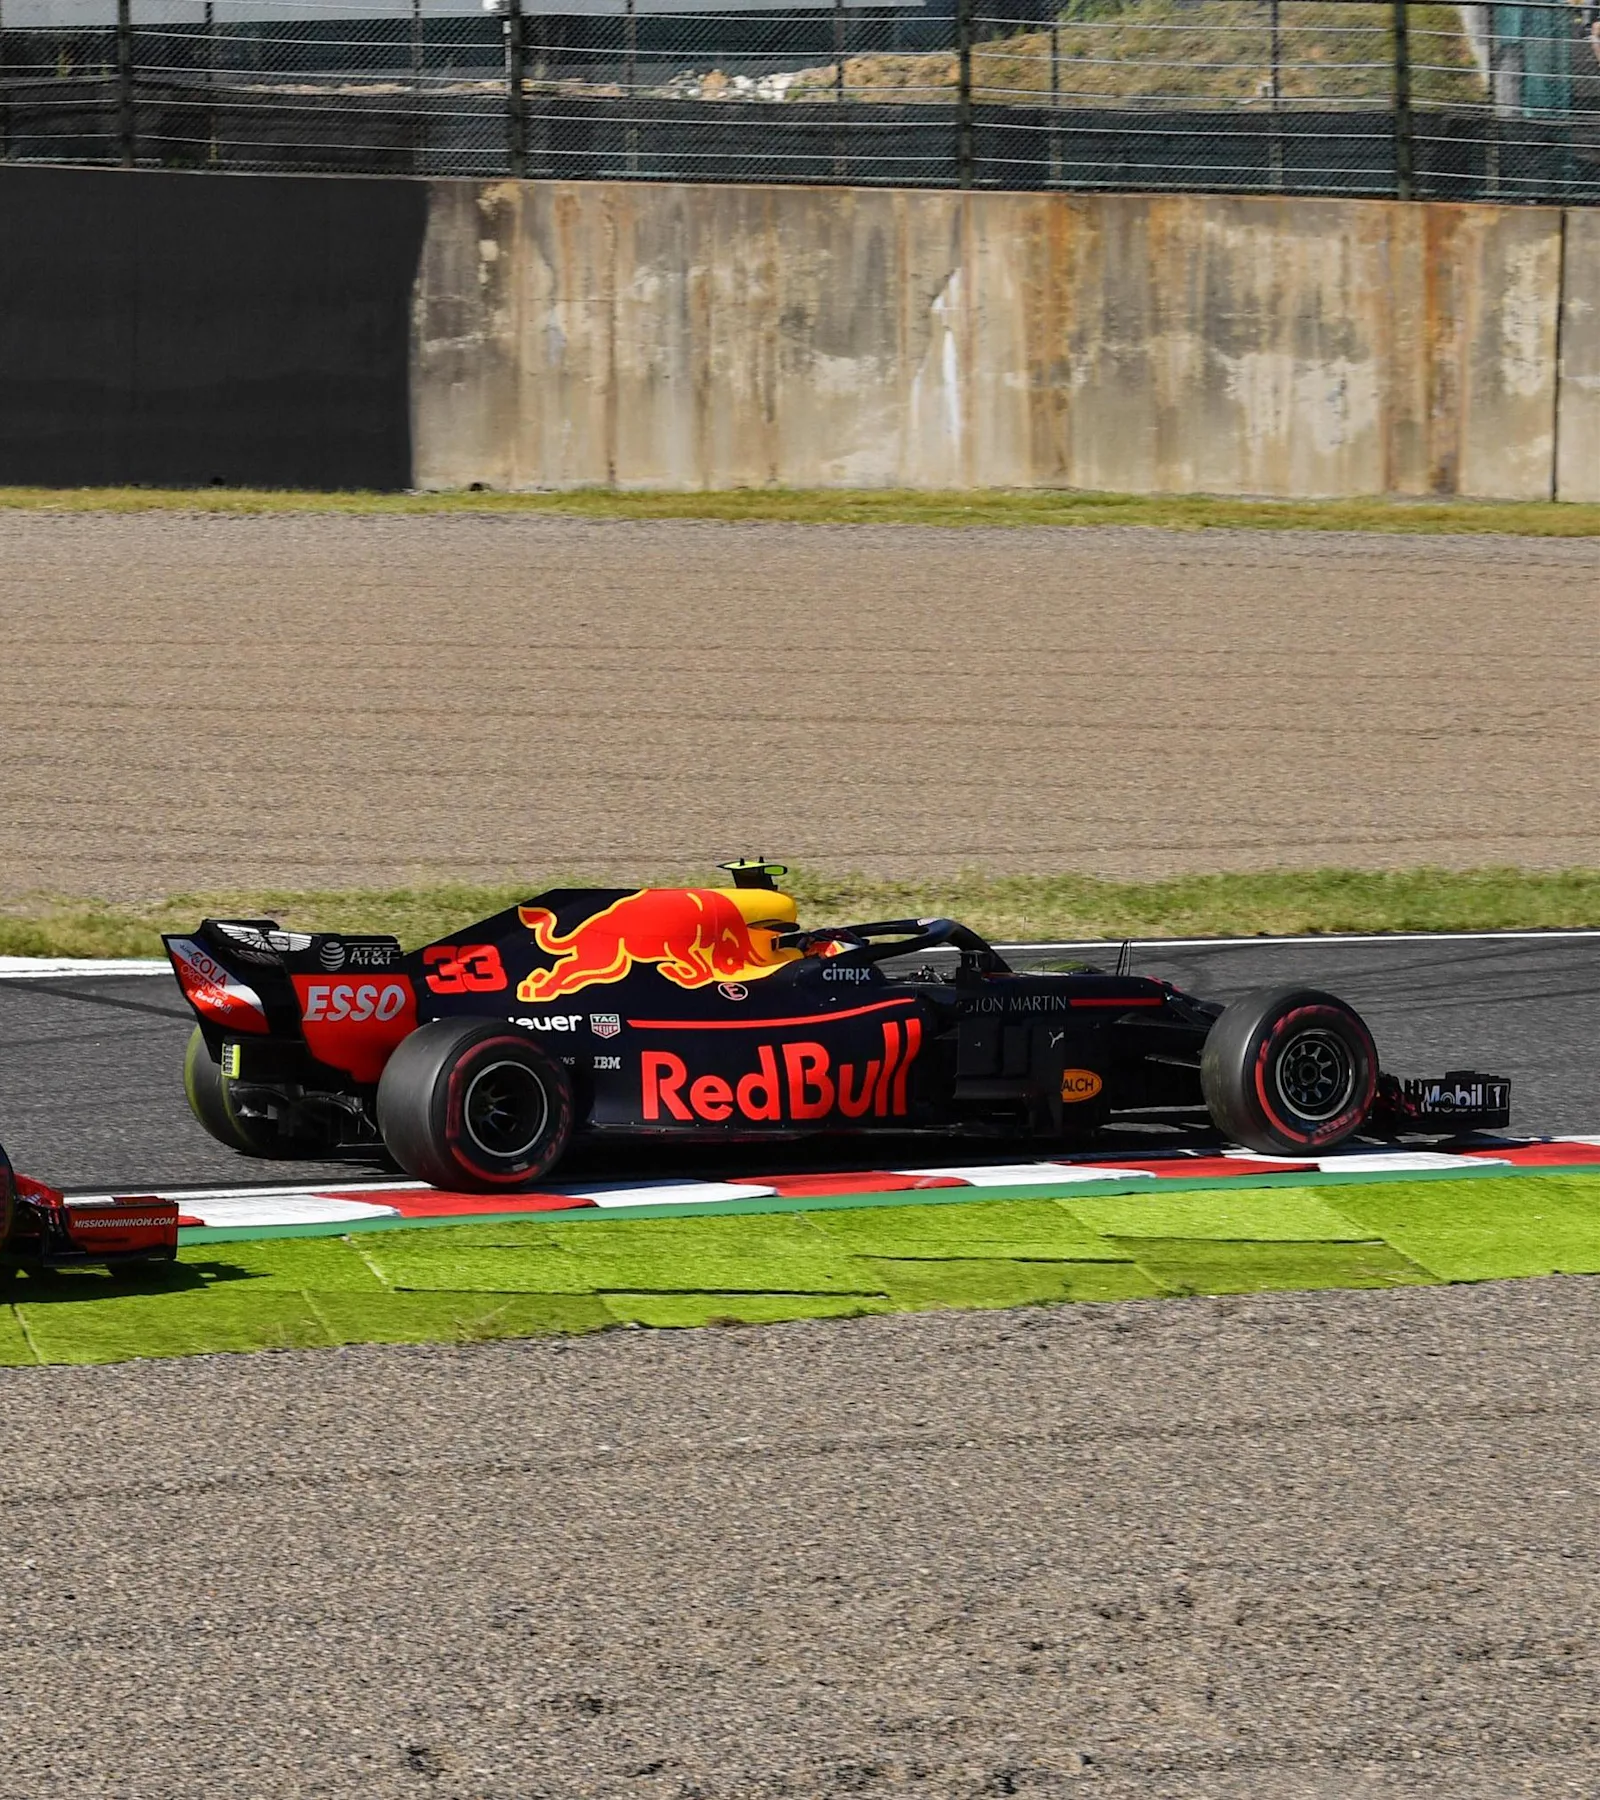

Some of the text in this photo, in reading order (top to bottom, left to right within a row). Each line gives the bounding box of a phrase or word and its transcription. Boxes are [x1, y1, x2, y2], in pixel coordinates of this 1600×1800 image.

[350, 947, 394, 966] AT&T
[422, 944, 508, 994] 33
[822, 963, 871, 985] CITRIX
[301, 984, 406, 1021] ESSO
[1009, 996, 1067, 1012] MARTIN
[593, 1056, 621, 1069] IBM
[1062, 1077, 1094, 1092] ALCH
[1421, 1084, 1501, 1113] Mobil 1
